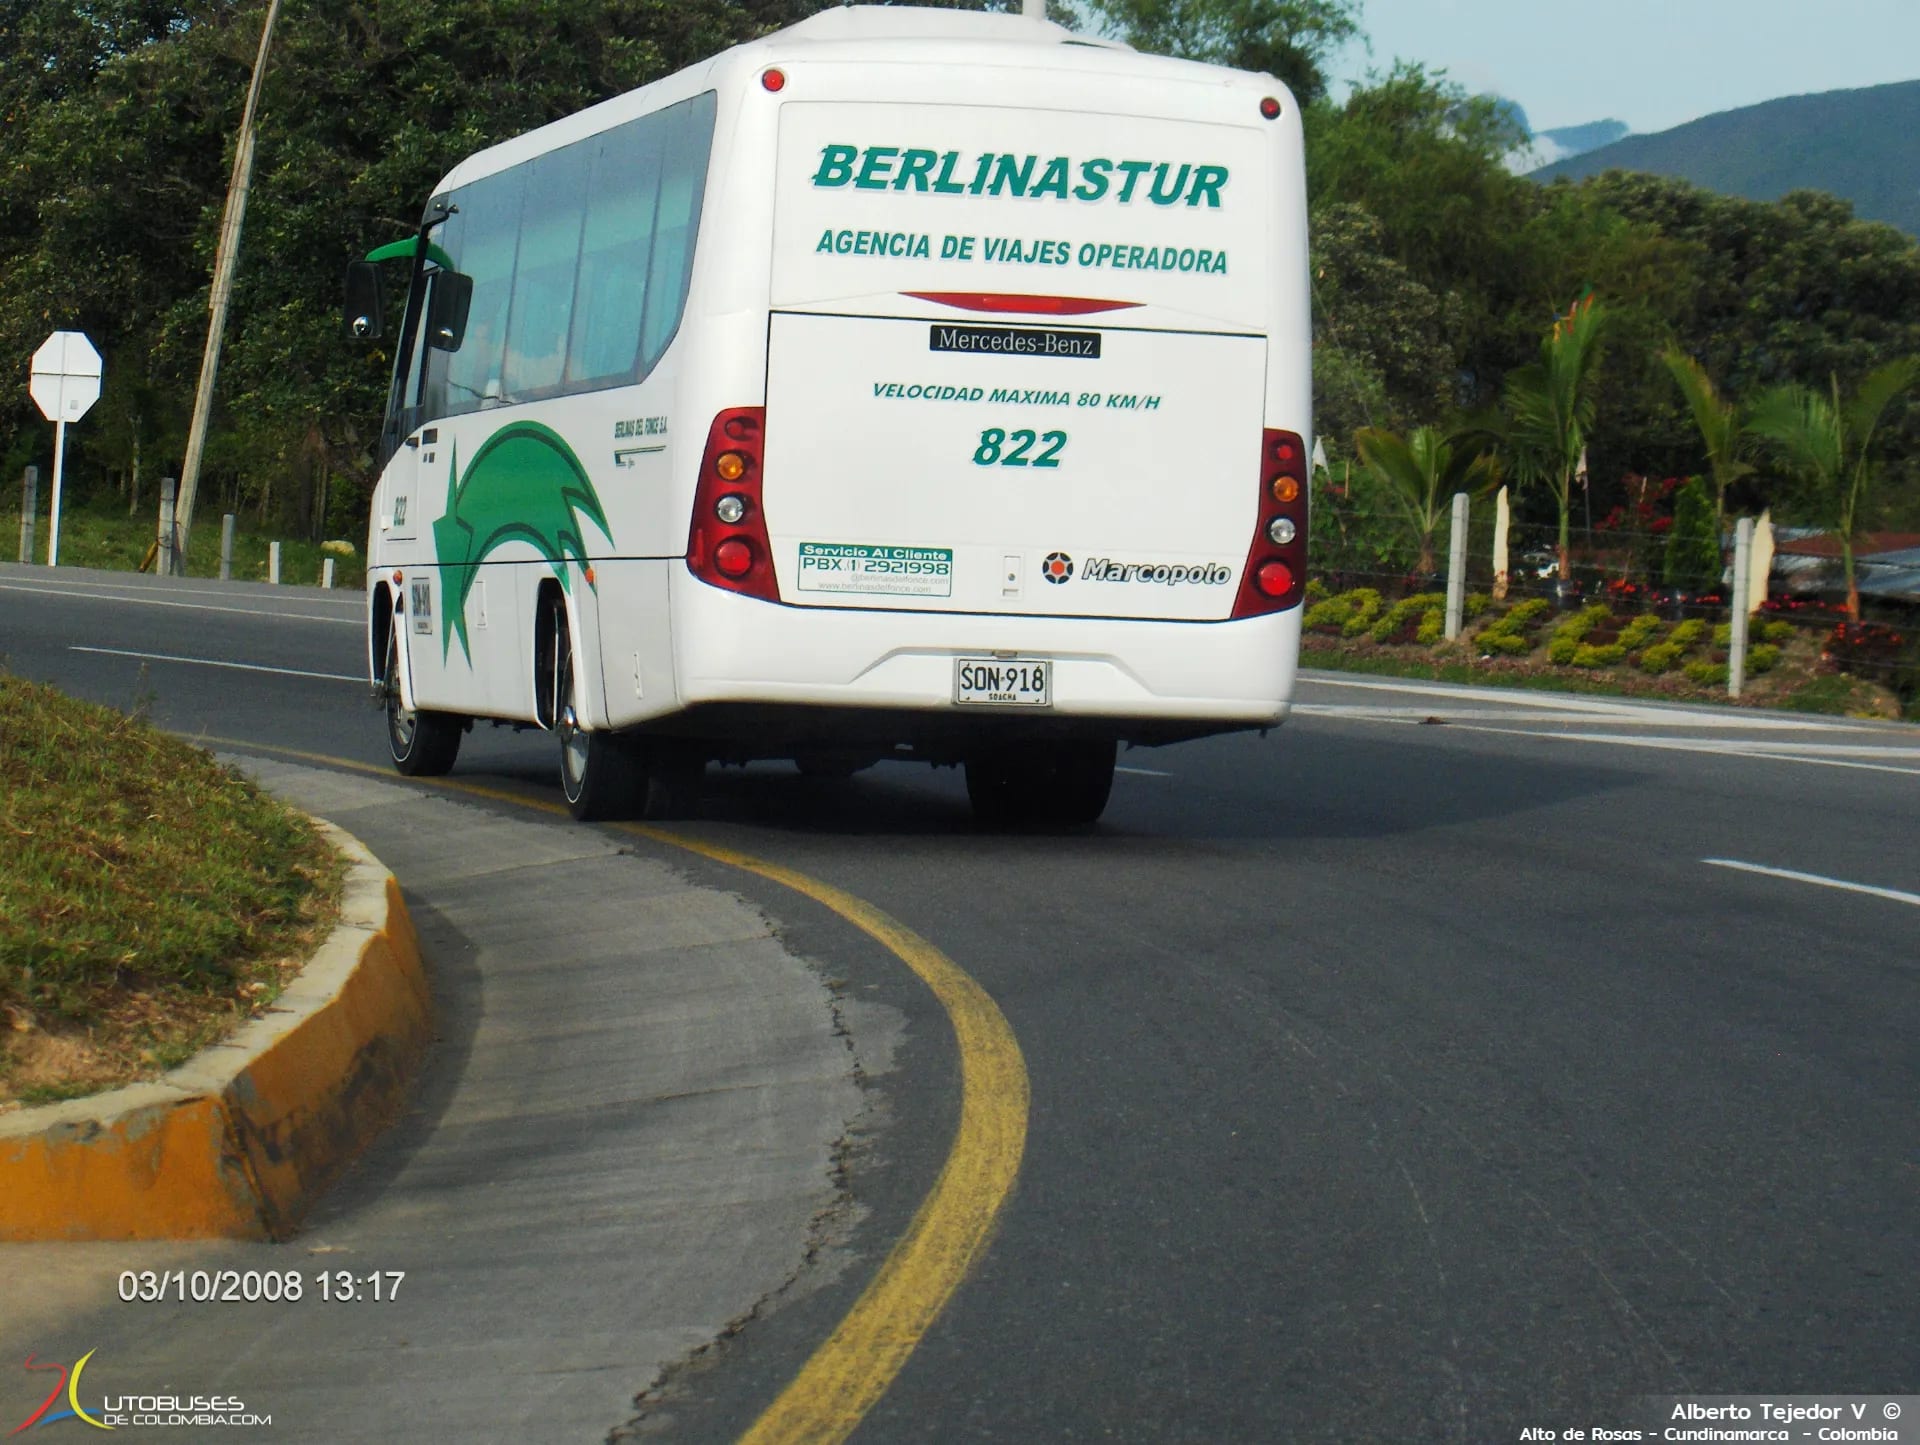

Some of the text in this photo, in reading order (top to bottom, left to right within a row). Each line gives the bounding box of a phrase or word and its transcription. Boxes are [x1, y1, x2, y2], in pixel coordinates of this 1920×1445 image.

[813, 143, 1230, 208] BERLINASTUR
[816, 229, 1228, 274] AGENCIA DE VIAJES OPERADORA
[939, 329, 1093, 355] Mercedes-Benz
[873, 382, 1162, 411] VELOCIDAD MAXIMA 80 KM/H
[972, 427, 1068, 468] 822
[804, 545, 947, 561] Servicio Al Cliente
[864, 560, 949, 575] 2921998
[1082, 557, 1231, 586] Marcopolo
[961, 667, 1044, 692] SON-918
[989, 693, 1017, 701] SOACHA
